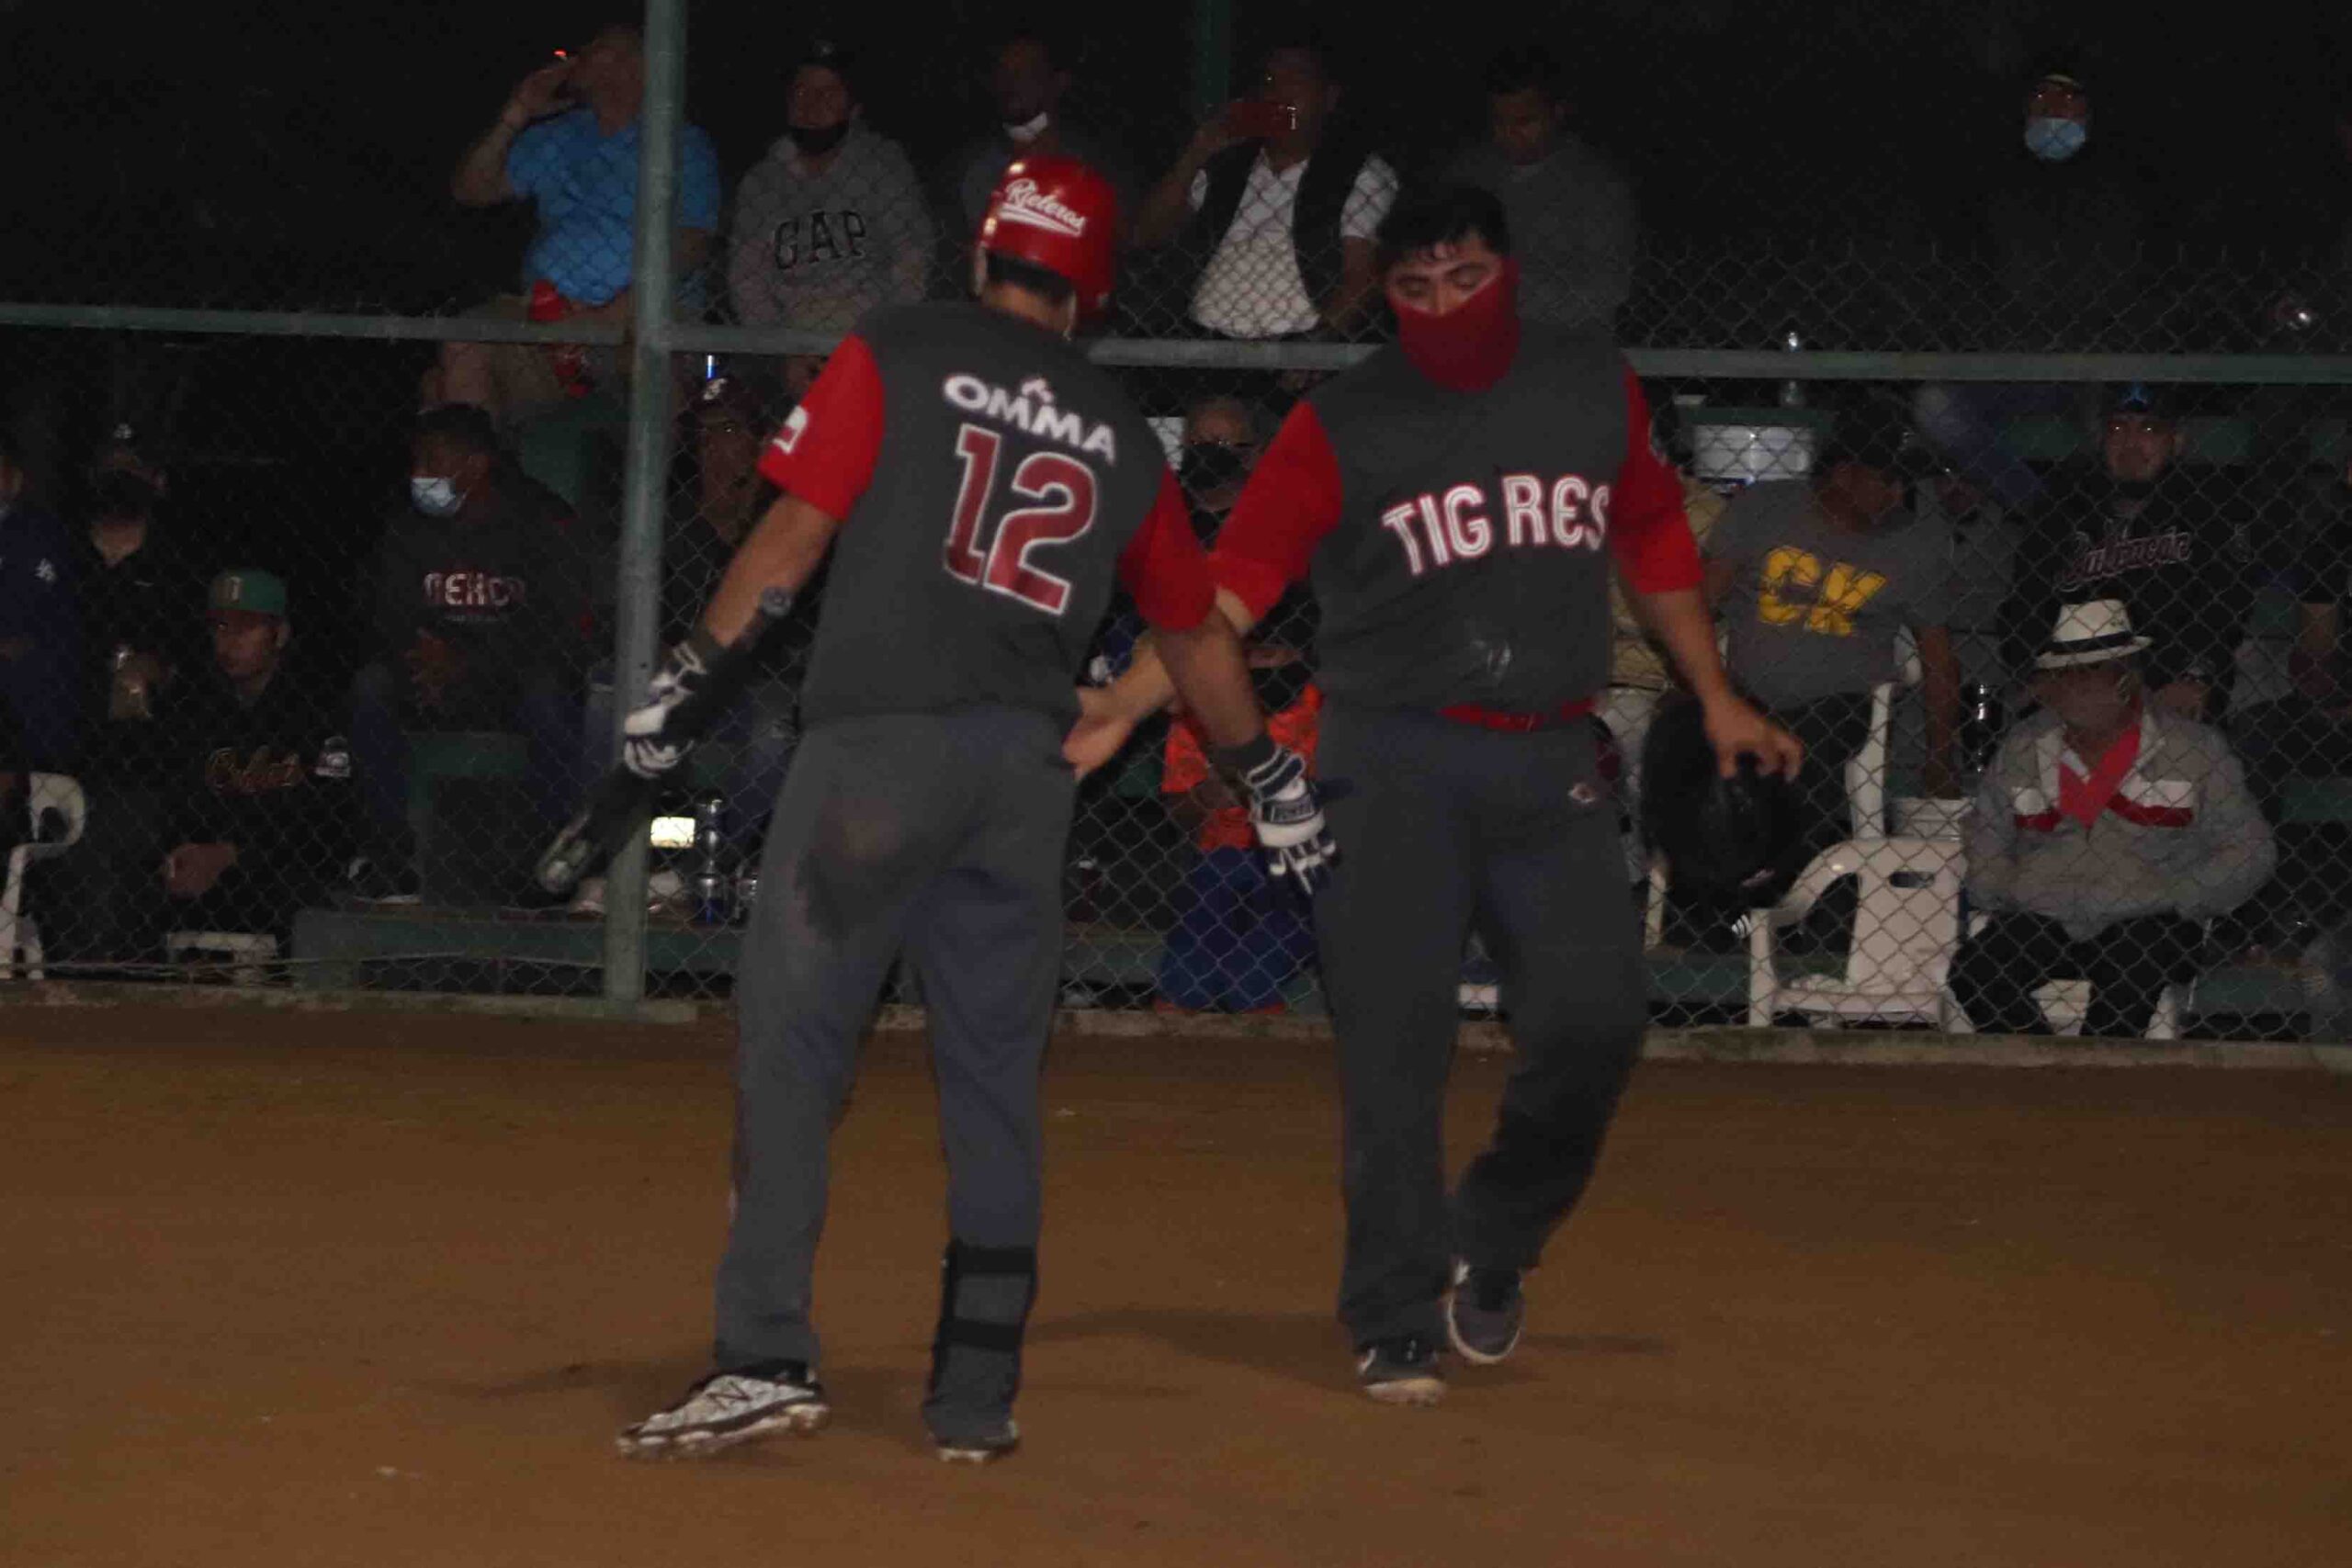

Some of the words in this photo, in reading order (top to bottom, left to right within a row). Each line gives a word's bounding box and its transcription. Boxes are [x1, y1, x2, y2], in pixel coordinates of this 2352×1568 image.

[775, 210, 865, 270] GAP
[944, 423, 1097, 616] 12
[1380, 473, 1611, 576] TIGRES
